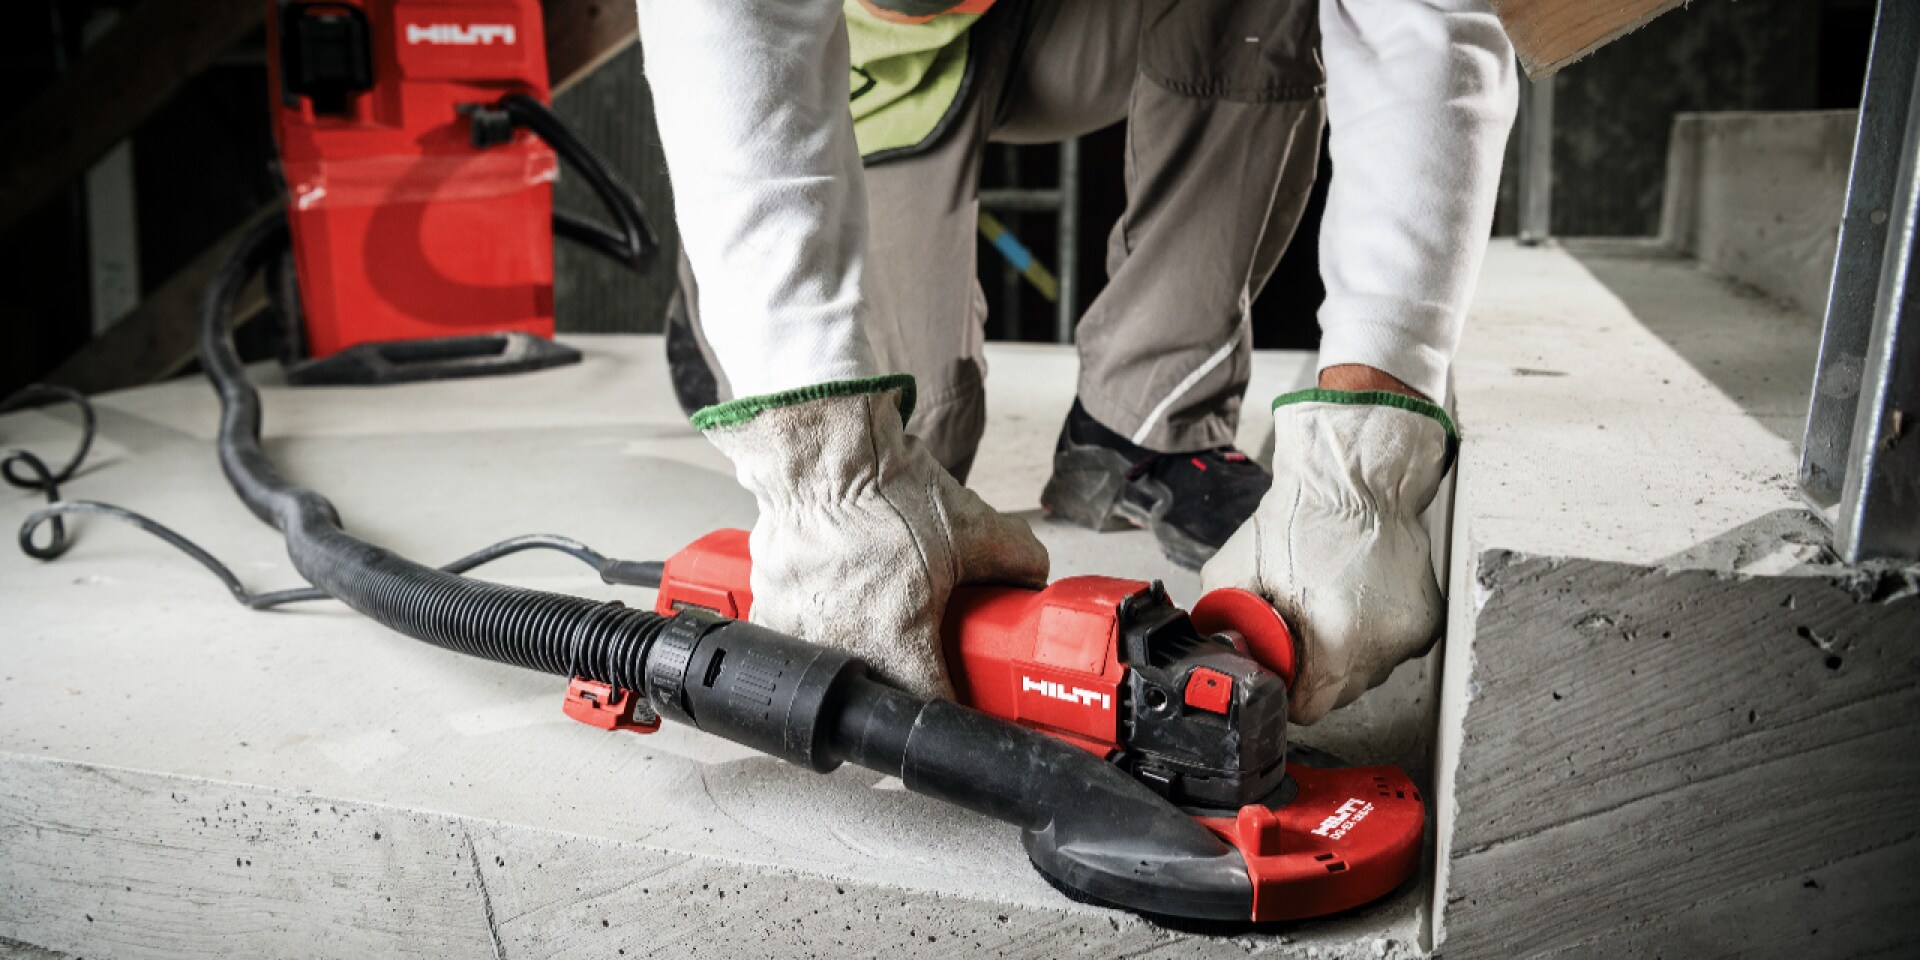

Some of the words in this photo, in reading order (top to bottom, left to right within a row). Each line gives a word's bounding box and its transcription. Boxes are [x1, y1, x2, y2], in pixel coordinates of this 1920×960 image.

[405, 23, 516, 45] HILTI
[1022, 675, 1111, 710] HILTI
[1311, 798, 1366, 836] HILTI
